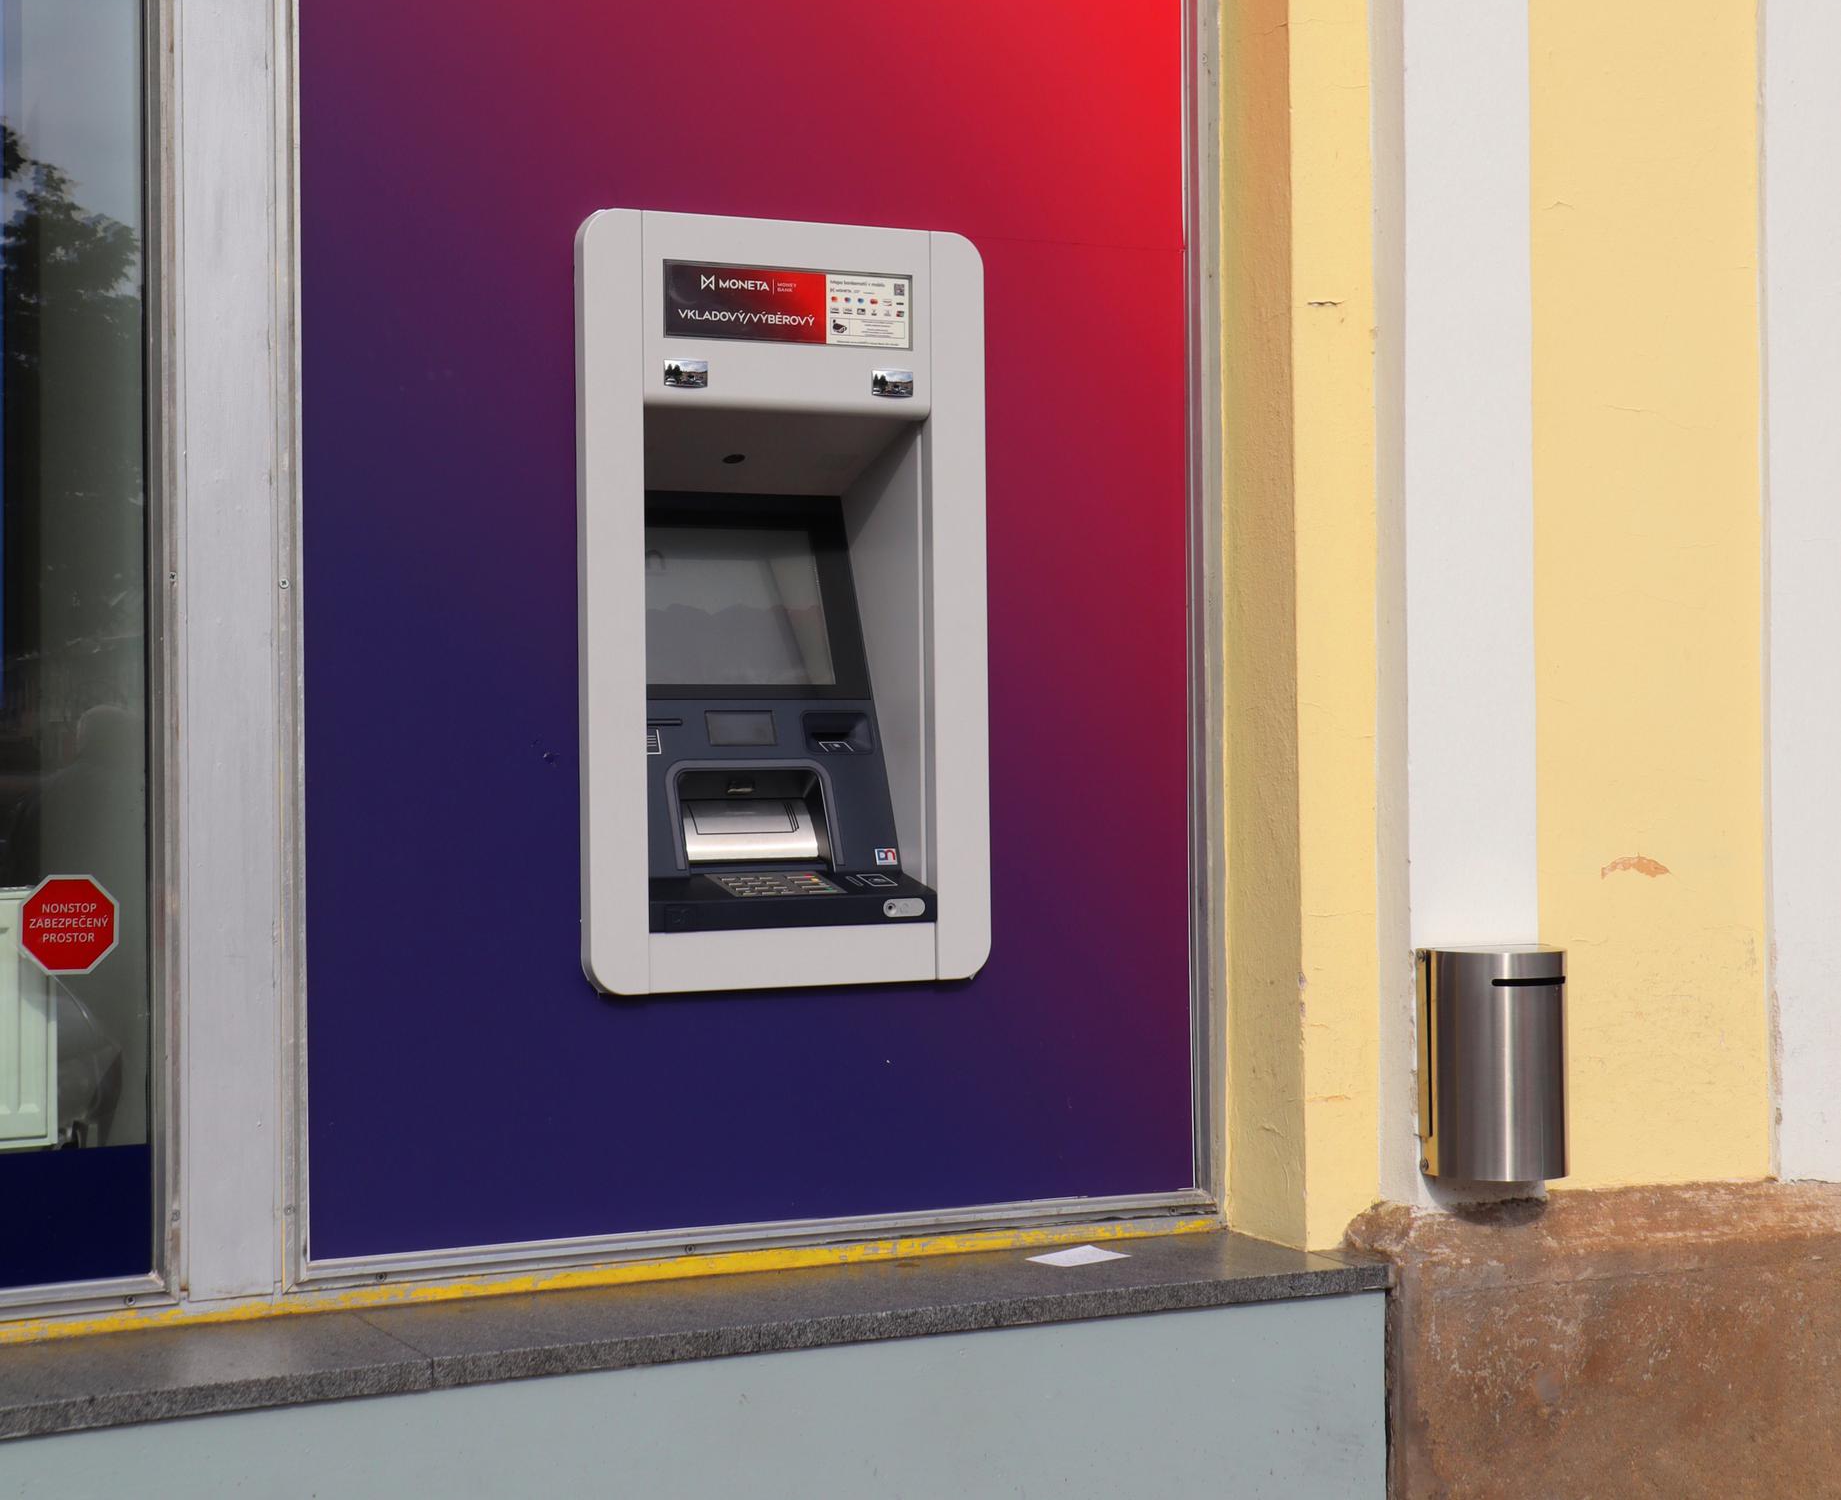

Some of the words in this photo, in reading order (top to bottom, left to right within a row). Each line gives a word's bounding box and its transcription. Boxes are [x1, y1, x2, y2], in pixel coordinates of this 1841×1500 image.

[719, 279, 770, 291] MONETA
[42, 903, 97, 913] NONSTOP
[29, 914, 109, 929] ZABEZPEČENÝ
[42, 932, 95, 943] PROSTOR
